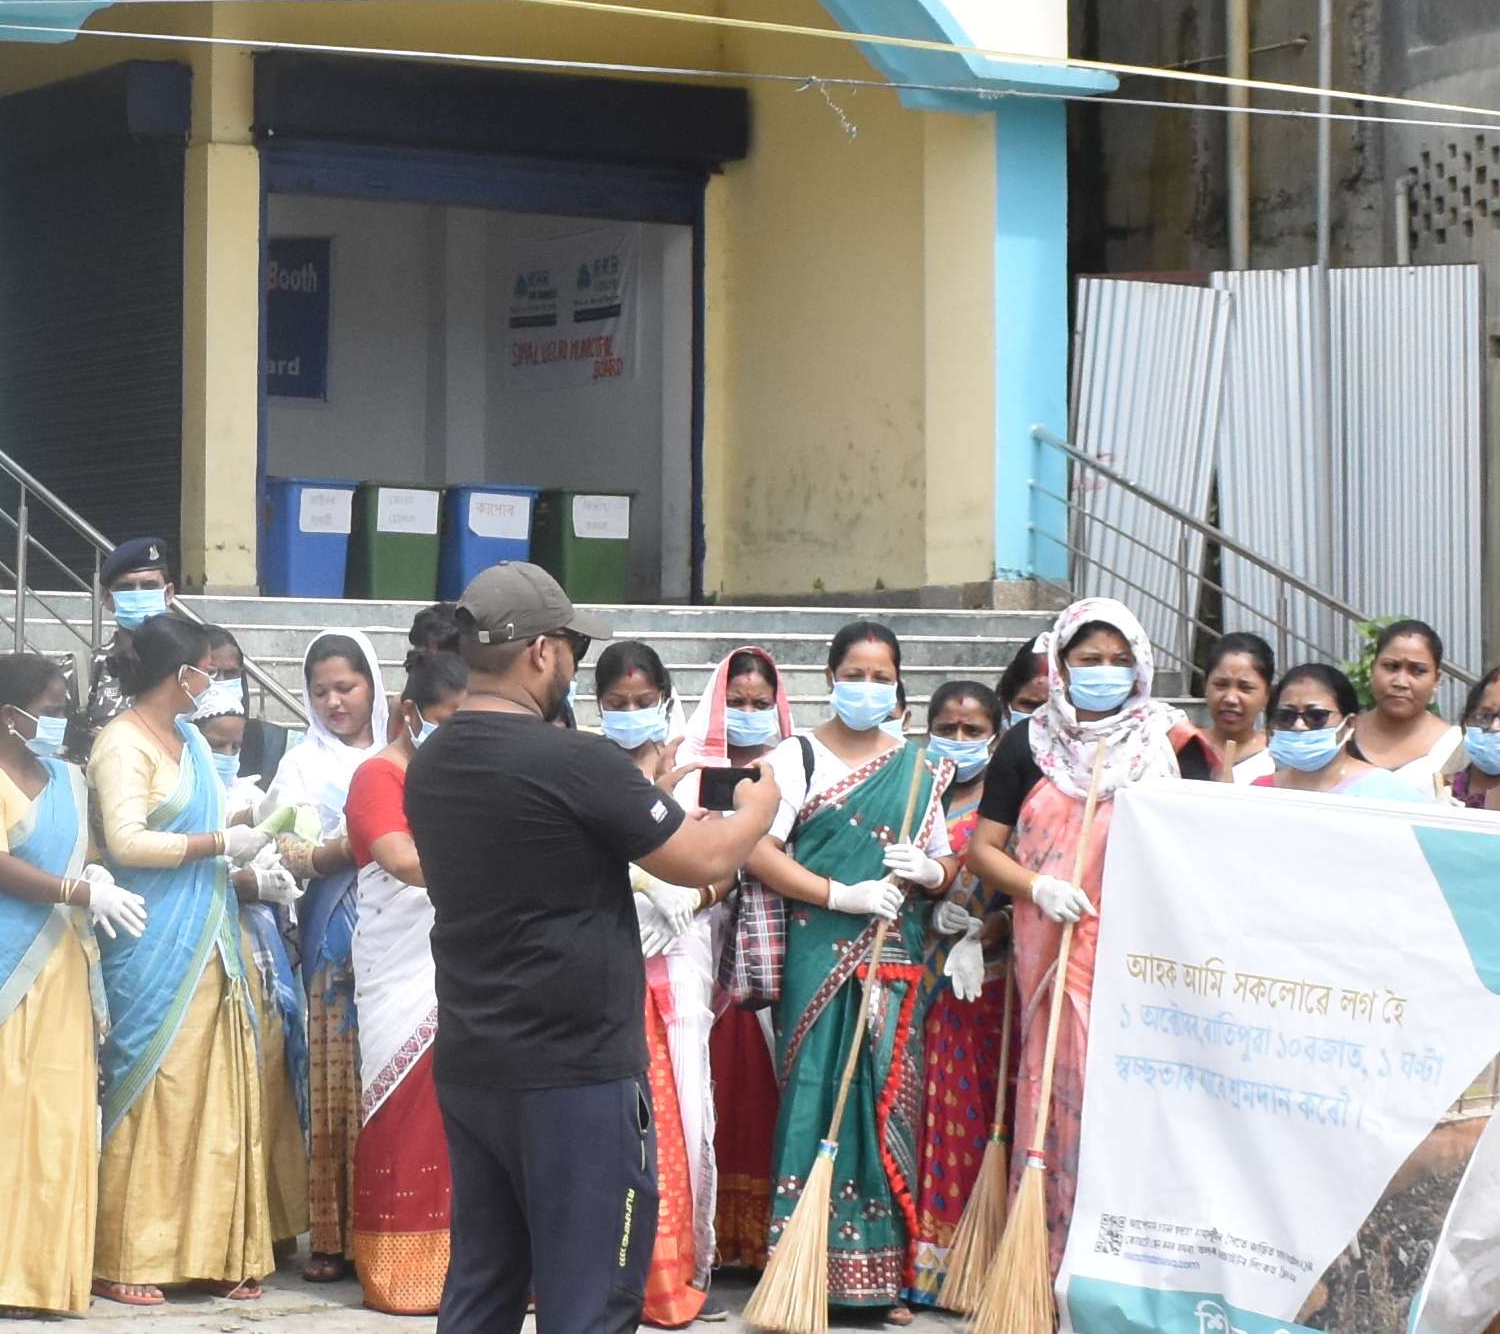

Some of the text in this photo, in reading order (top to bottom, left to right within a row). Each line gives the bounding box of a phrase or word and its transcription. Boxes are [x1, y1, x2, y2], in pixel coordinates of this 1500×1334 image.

[266, 356, 300, 376] ard
[1183, 957, 1226, 999] আমি
[1341, 987, 1378, 1024] লগ
[1382, 986, 1407, 1028] হৈ
